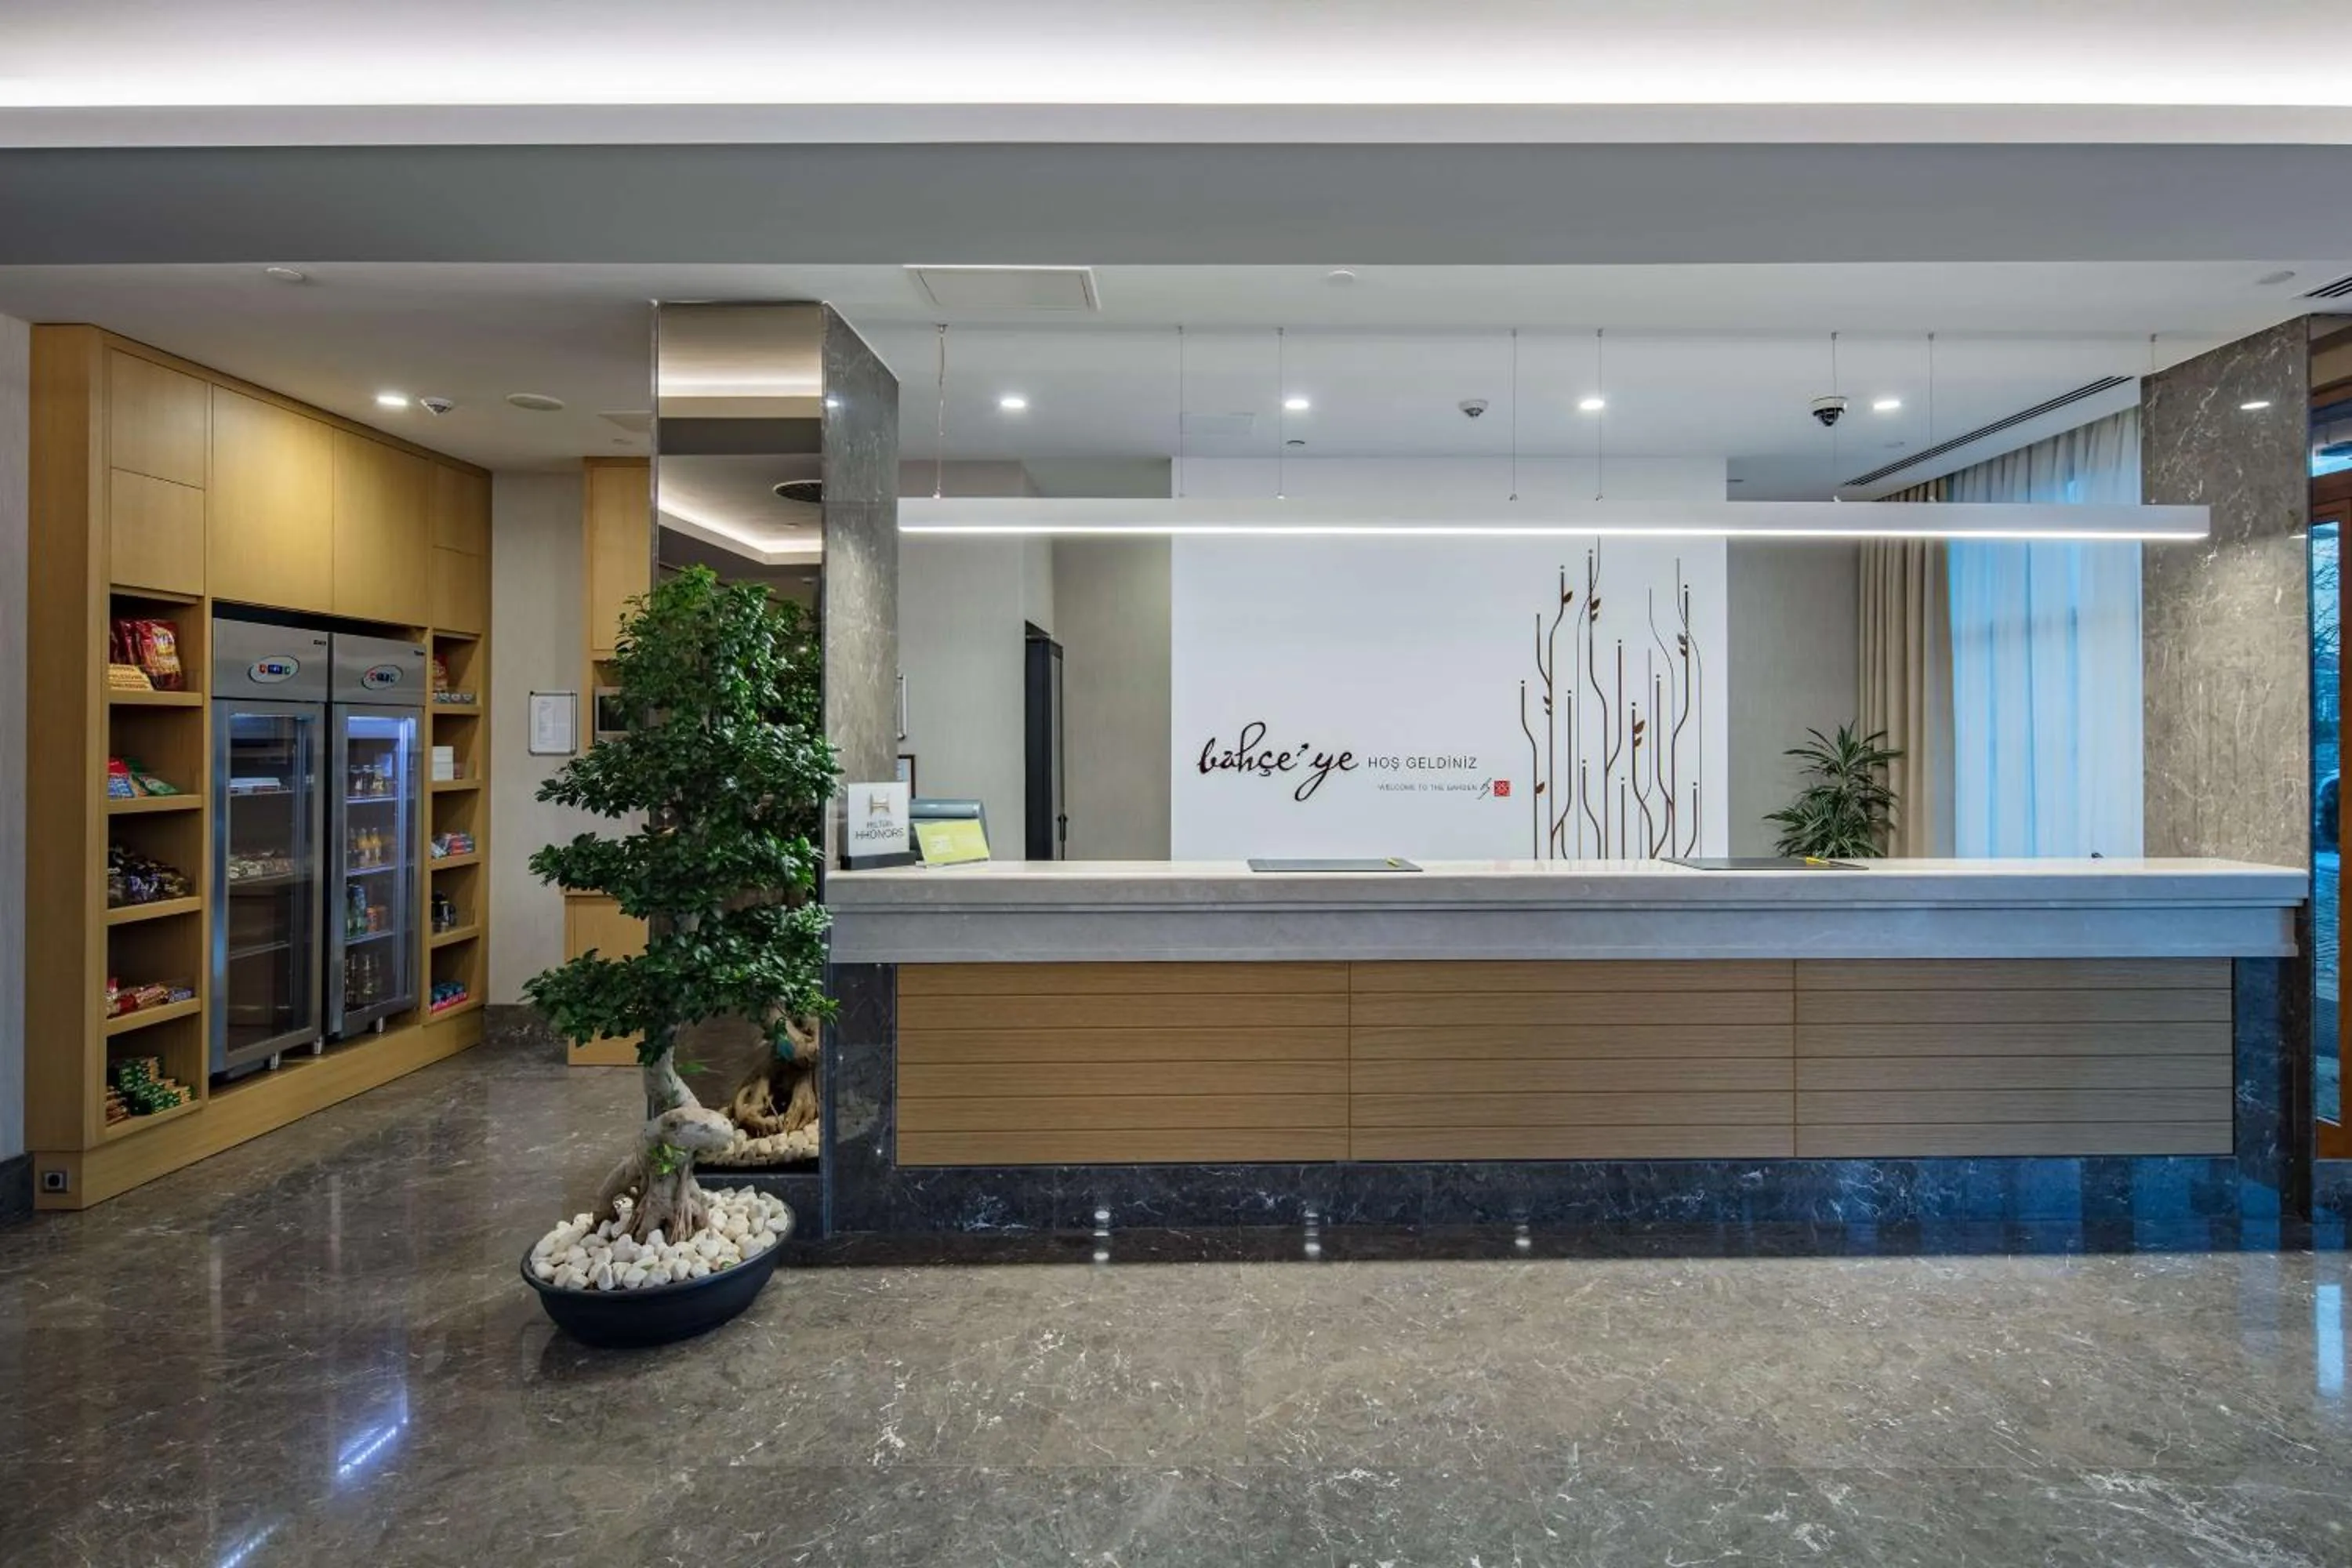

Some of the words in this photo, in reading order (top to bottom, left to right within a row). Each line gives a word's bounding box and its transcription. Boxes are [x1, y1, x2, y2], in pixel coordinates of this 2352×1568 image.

[1368, 756, 1399, 771] HOŞ
[1406, 755, 1478, 769] GELDİNİZ
[1378, 783, 1416, 792] WELCOME
[1418, 783, 1428, 792] TO
[1431, 783, 1445, 792] THE
[1446, 783, 1478, 792] GARDEN
